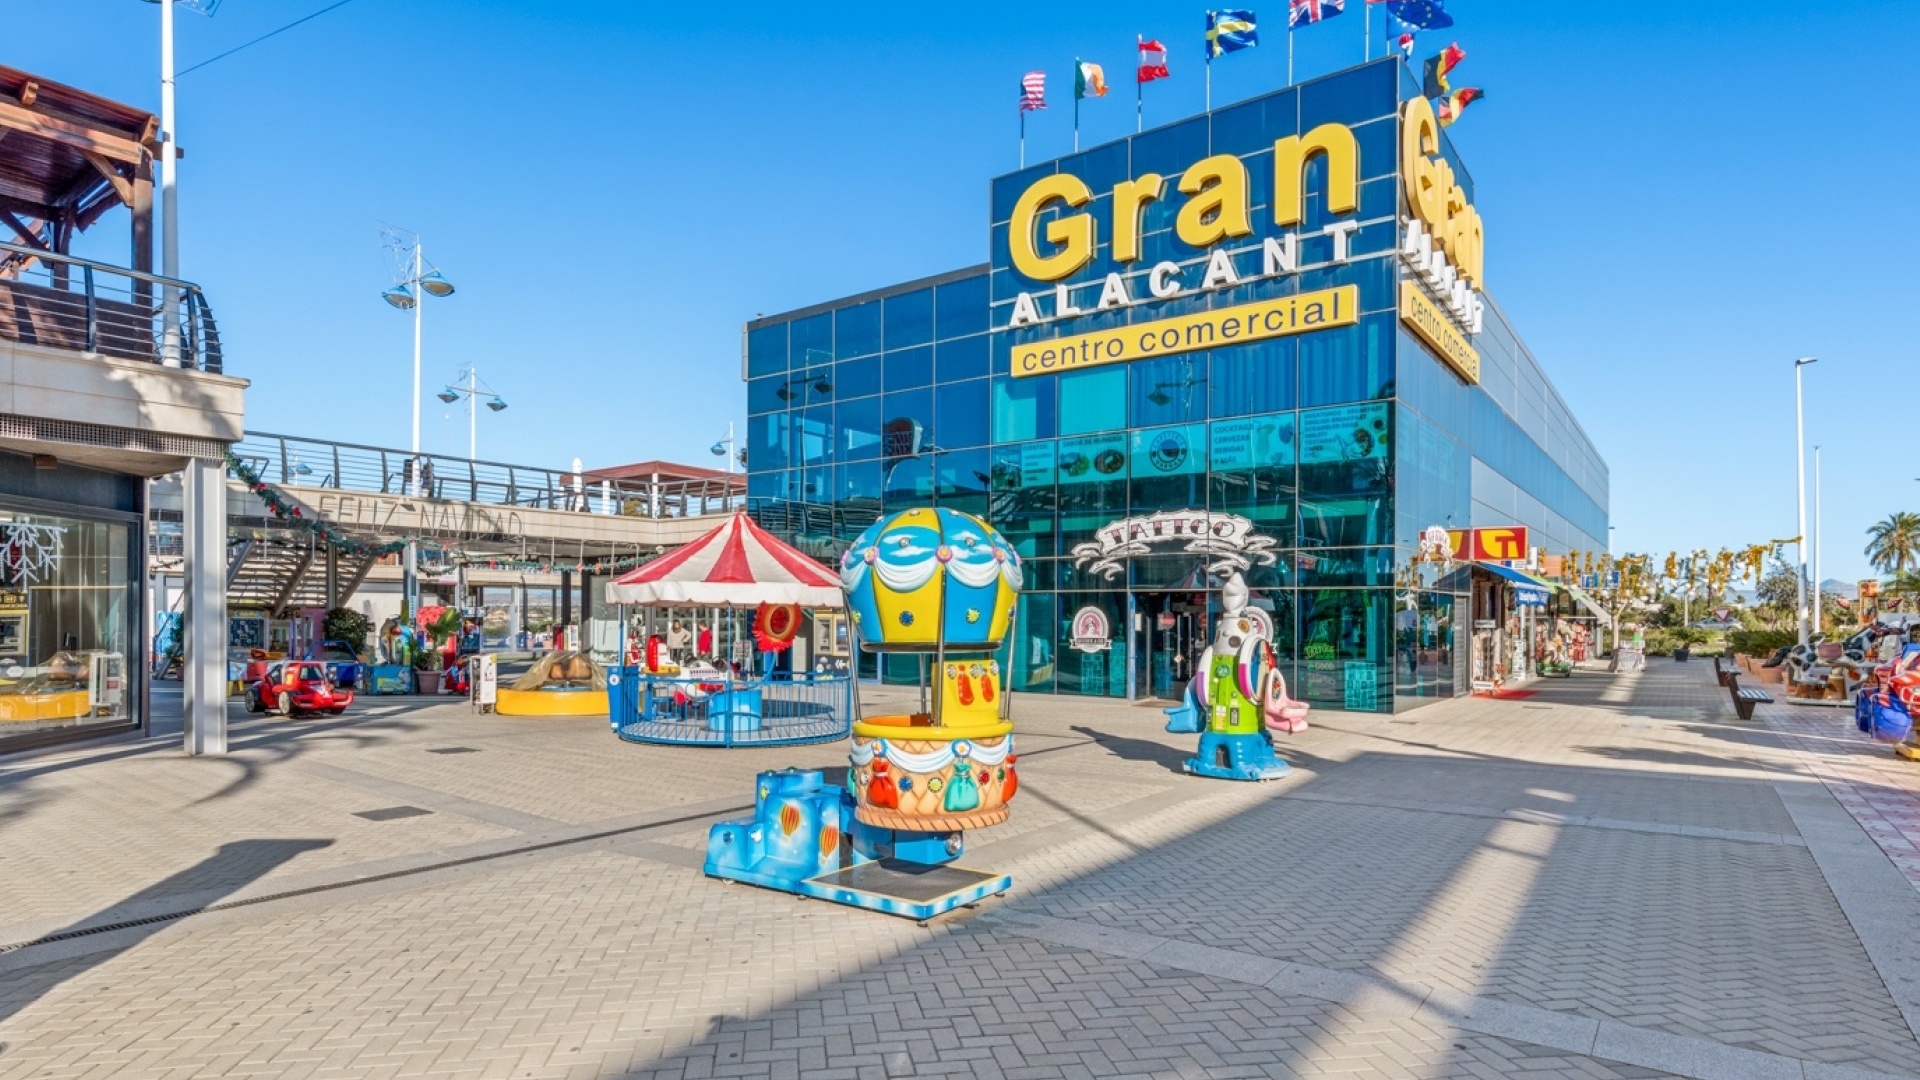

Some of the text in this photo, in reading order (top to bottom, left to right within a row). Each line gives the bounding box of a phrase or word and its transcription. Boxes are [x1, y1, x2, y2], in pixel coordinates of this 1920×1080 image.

[1009, 122, 1360, 283] Gran
[1009, 220, 1359, 328] ALACANT
[1022, 292, 1341, 372] centro comercial
[1411, 296, 1441, 342] centro
[1214, 423, 1254, 434] COCKTAILS
[1214, 433, 1250, 444] CERVEZAS
[1214, 444, 1245, 454] BEBIDAS
[318, 494, 523, 542] FELIZ NAVIDAD
[1104, 519, 1235, 544] TATTOO
